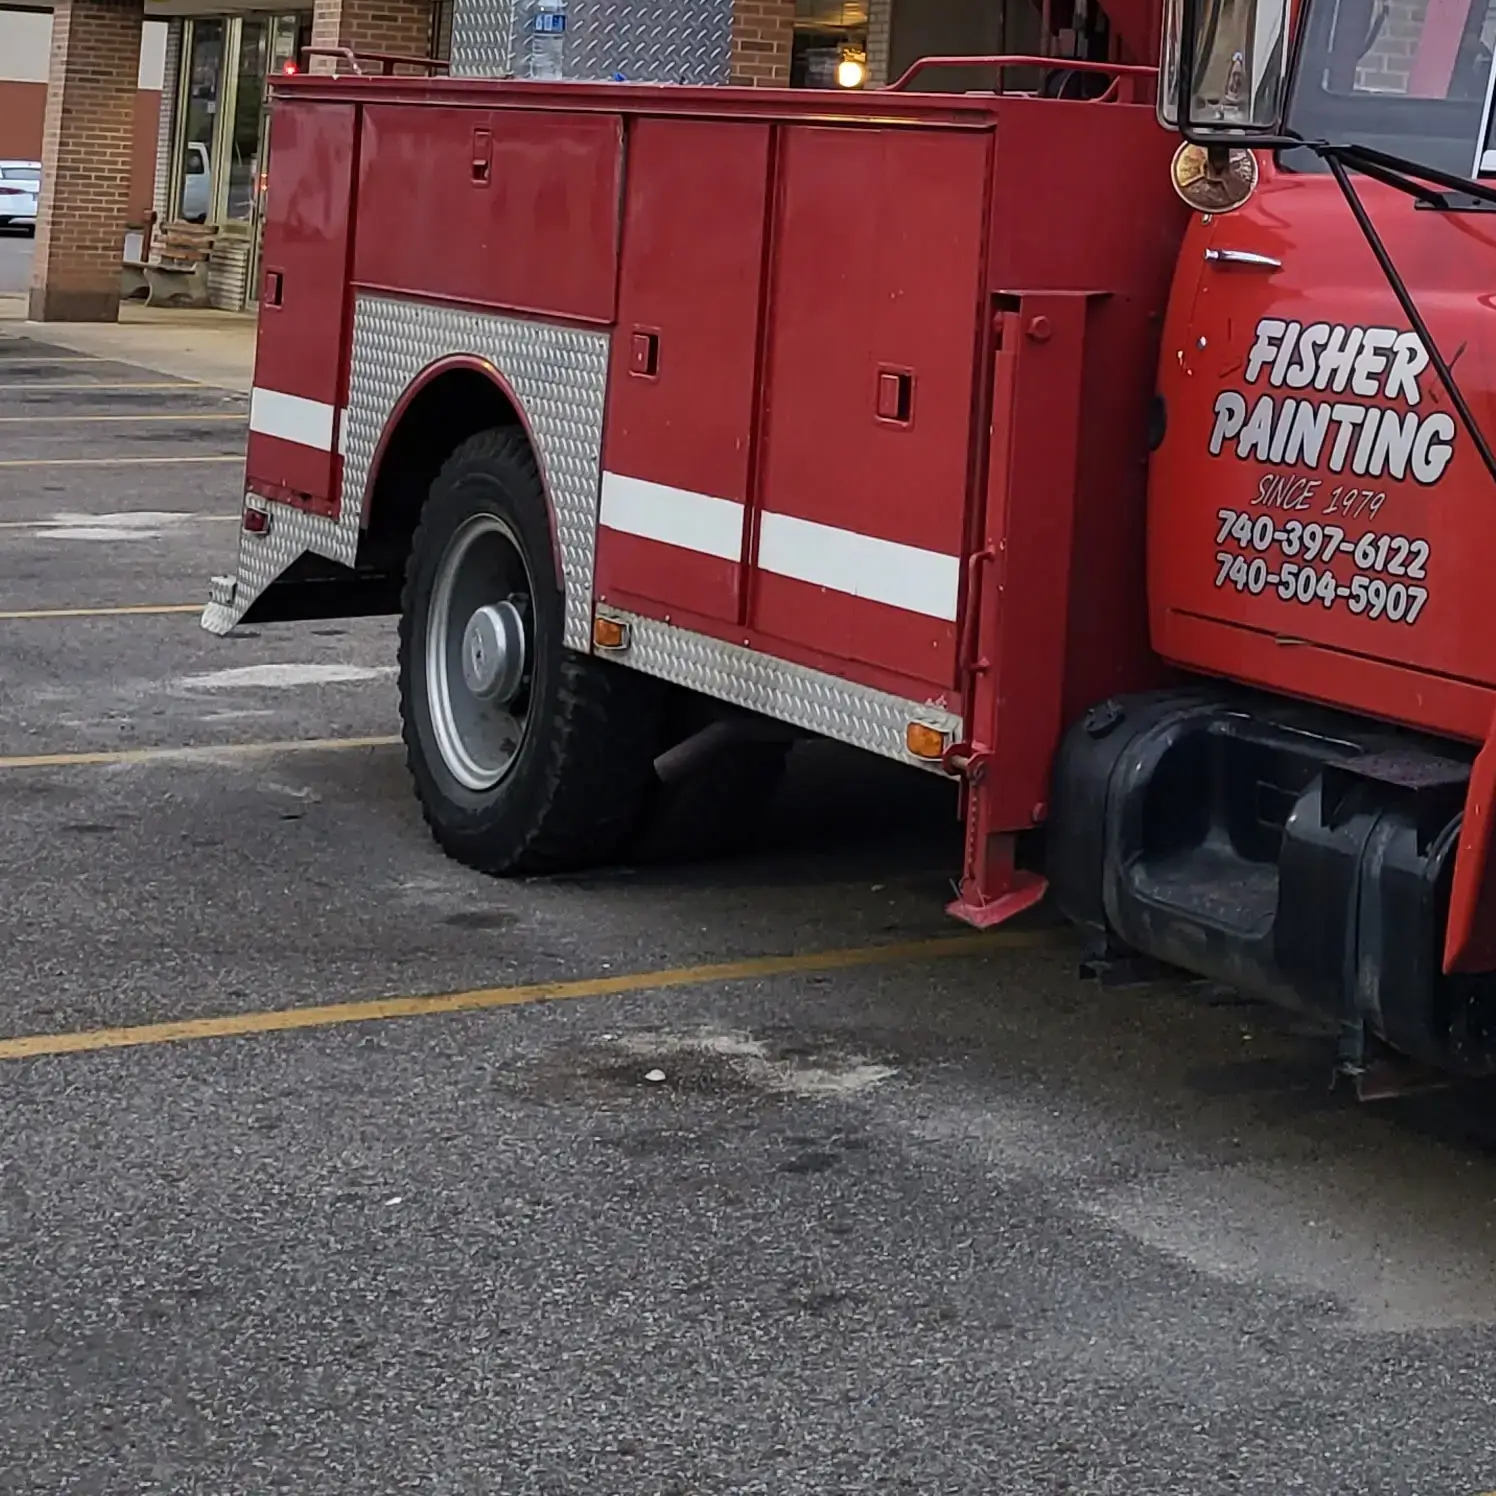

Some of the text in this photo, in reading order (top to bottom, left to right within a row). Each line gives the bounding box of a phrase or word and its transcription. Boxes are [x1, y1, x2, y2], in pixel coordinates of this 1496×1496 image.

[1245, 318, 1430, 406] FISHER
[1209, 391, 1455, 484] PAINTING
[1250, 473, 1386, 521] SINCE 1979
[1215, 509, 1430, 579] 740-397-6122
[1214, 553, 1428, 624] 740-504-5907
